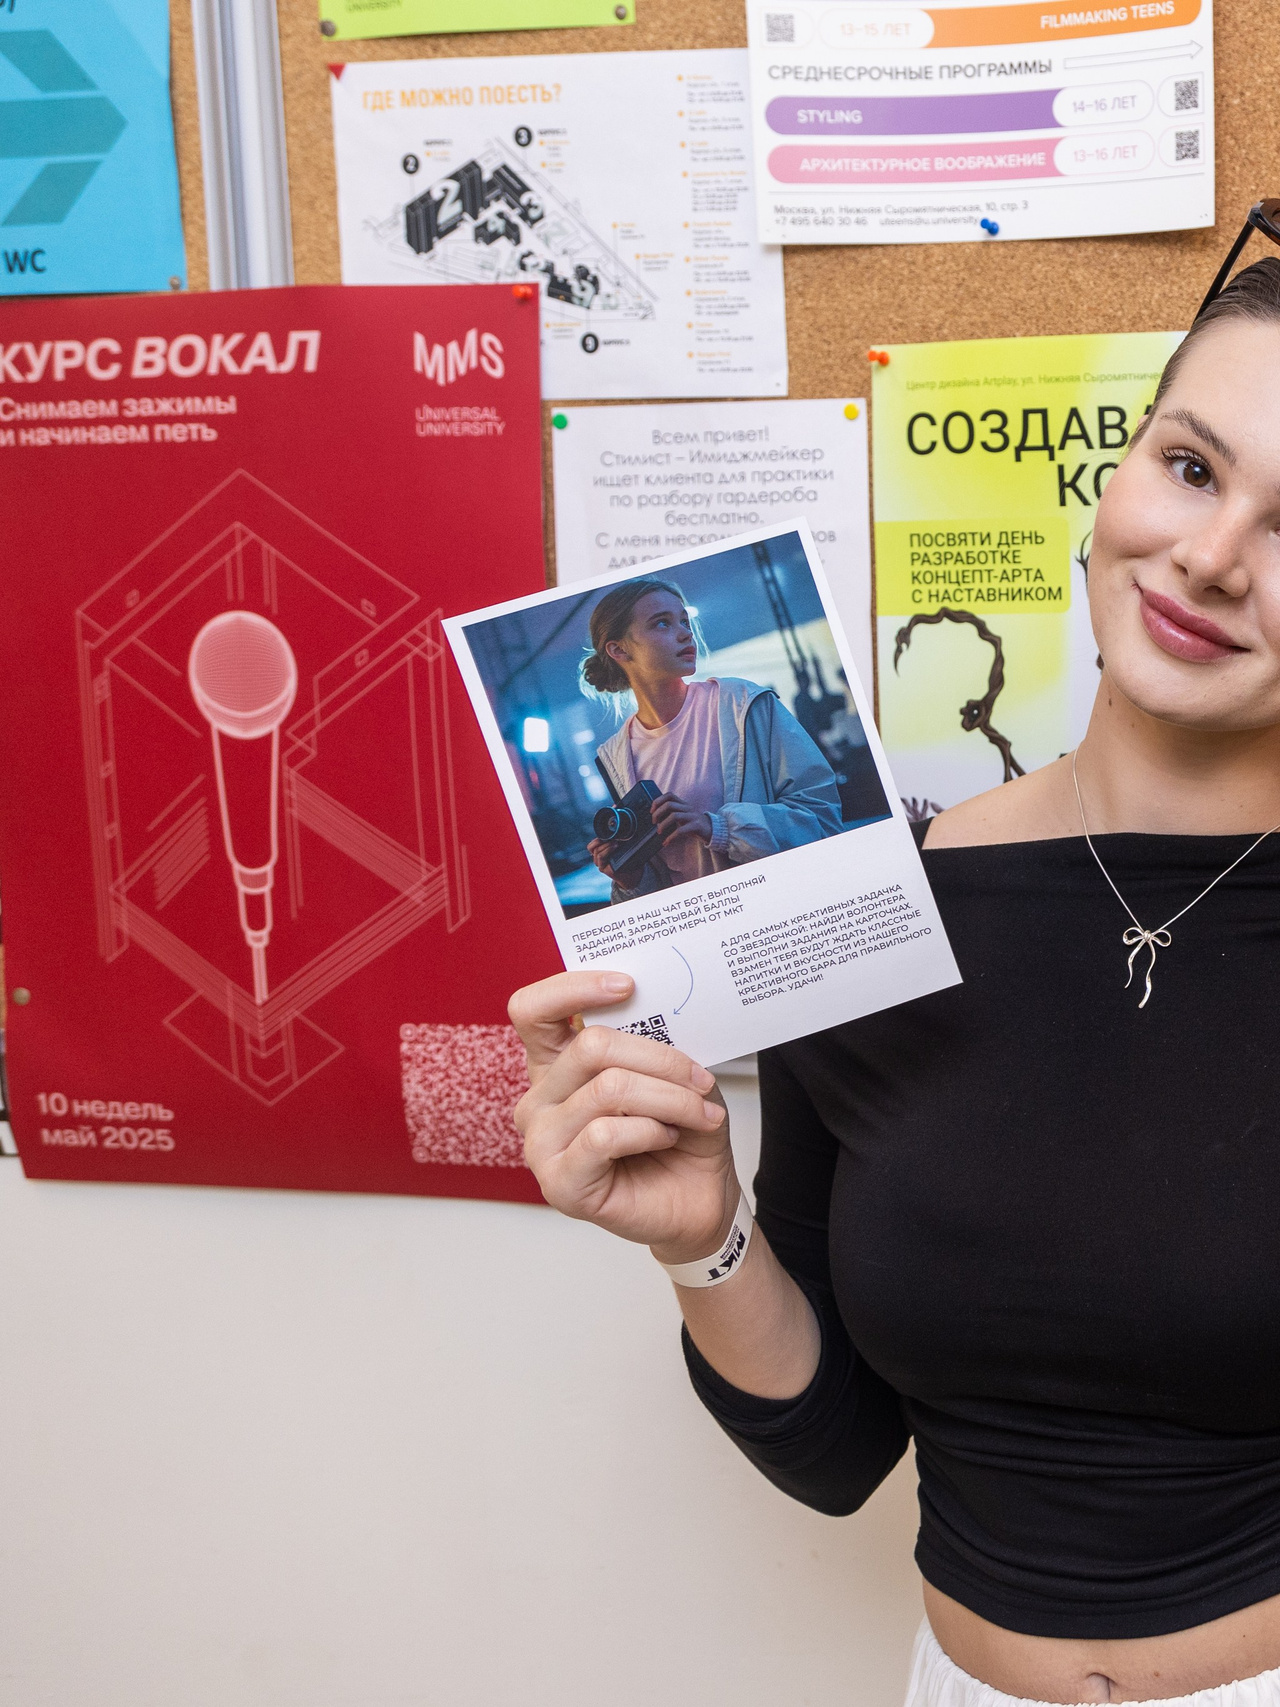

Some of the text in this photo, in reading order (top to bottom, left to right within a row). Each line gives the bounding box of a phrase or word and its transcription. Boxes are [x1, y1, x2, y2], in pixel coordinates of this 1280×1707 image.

[1040, 1, 1175, 29] FILMMAKING TEENS
[882, 22, 910, 36] ЛЕТ
[768, 59, 1052, 82] СРЕДНЕСРОЧНЫЕ ПРОГРАММЫ
[363, 83, 562, 112] ГДЕ МОЖНО ПОЕСТЬ?
[1111, 95, 1137, 110] ЛЕТ
[797, 109, 863, 124] STYLING
[800, 152, 1046, 172] АРХИТЕКТУРНОЕ ВООБРАЖЕНИЕ
[1112, 145, 1138, 160] ЛЕТ
[5, 249, 47, 274] WC
[0, 330, 321, 384] КУРС ВОКАЛ
[0, 396, 238, 422] Снимаем зажимы
[19, 424, 149, 447] начинаем
[154, 422, 218, 443] петь
[416, 421, 506, 437] UNIVERSITY
[652, 426, 770, 445] Всем привет!
[907, 404, 1153, 463] СОЗДАВ
[600, 446, 825, 467] Стилист Имиджмейкер
[593, 468, 834, 488] ищет клиента для практики
[610, 485, 818, 508] по разбору гардероба
[664, 510, 765, 526] бесплатно.
[614, 534, 661, 547] меня
[909, 531, 1045, 548] ПОСВЯТИ ДЕНЬ
[910, 550, 1022, 566] РАЗРАБОТКЕ
[911, 568, 1045, 586] КОНЦЕПТ-АРТА
[911, 586, 1062, 603] С НАСТАВНИКОМ
[572, 874, 766, 942] ПЕРЕХОДИ В НАШ ЧАТ БОТ, ВЫПОЛНЯЙ
[730, 932, 751, 946] ДЛЯ
[752, 920, 789, 937] САМЫХ
[790, 898, 856, 925] КРЕАТИВНЫХ
[857, 884, 902, 904] ЗАДАЧКА
[575, 895, 740, 953] ЗАДАНИЯ, ЗАРАБАТЫВАЙ БАЛЛЫ
[579, 904, 743, 963] И ЗАБИРАЙ КРУТОЙ МЕРЧ ОТ МКТ
[723, 894, 906, 958] СО ЗВЕЗДОЧКОЙ: НАЙДИ ВОЛОНТЕРА
[727, 902, 913, 968] И ВЫПОЛНИ ЗАДАНИЯ НА КАРТОЧКАХ.
[731, 909, 921, 978] ВЗАМЕН ТЕБЯ БУДУТ ЖДАТЬ КЛАССНЫЕ
[734, 924, 909, 987] НАПИТКИ И ВКУСНОСТИ ИЗ НАШЕГО
[738, 927, 932, 997] КРЕАТИВНОГО БАРА ДЛЯ ПРАВИЛЬНОГО
[741, 973, 824, 1006] ВЫБОРА. УДАЧИ!
[37, 1092, 175, 1123] 10 недель
[40, 1125, 175, 1151] май 2025
